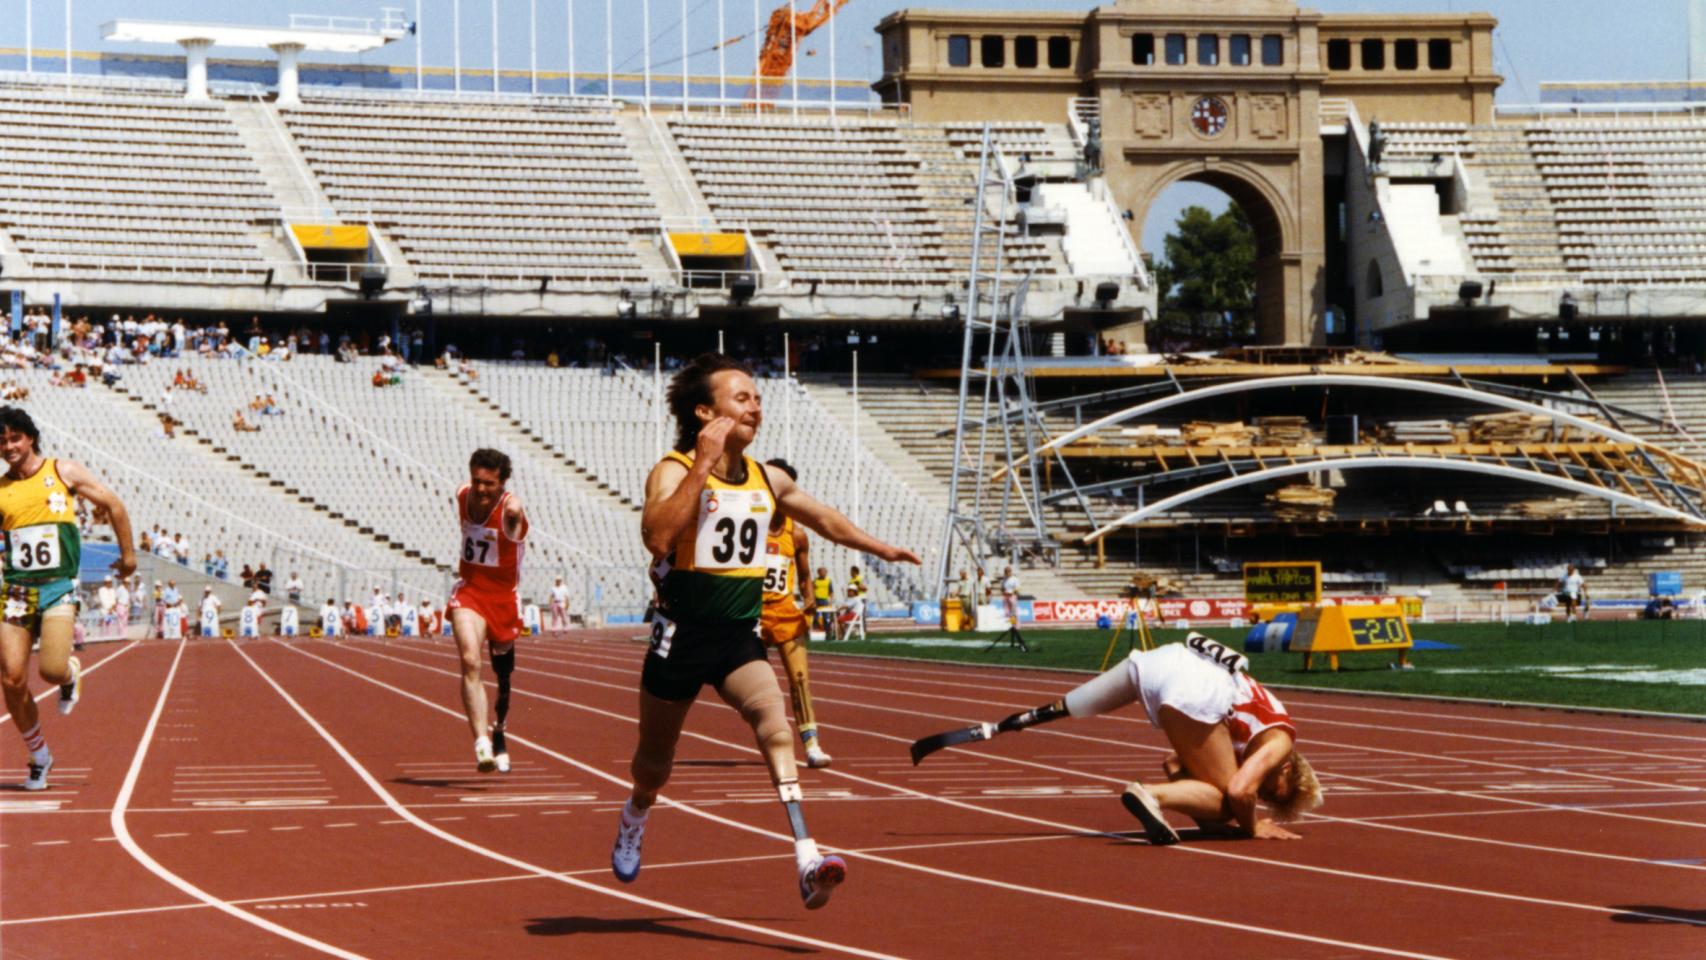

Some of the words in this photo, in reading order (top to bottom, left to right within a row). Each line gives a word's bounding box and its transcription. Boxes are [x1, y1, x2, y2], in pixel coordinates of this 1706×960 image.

[711, 516, 758, 564] 39
[20, 541, 52, 568] 36
[464, 537, 489, 563] 67
[205, 610, 215, 624] 9
[244, 610, 253, 624] 8
[285, 610, 294, 622] 7
[327, 611, 336, 622] 6
[372, 610, 380, 622] 5
[406, 610, 415, 622] 4
[1352, 618, 1404, 643] -2.0
